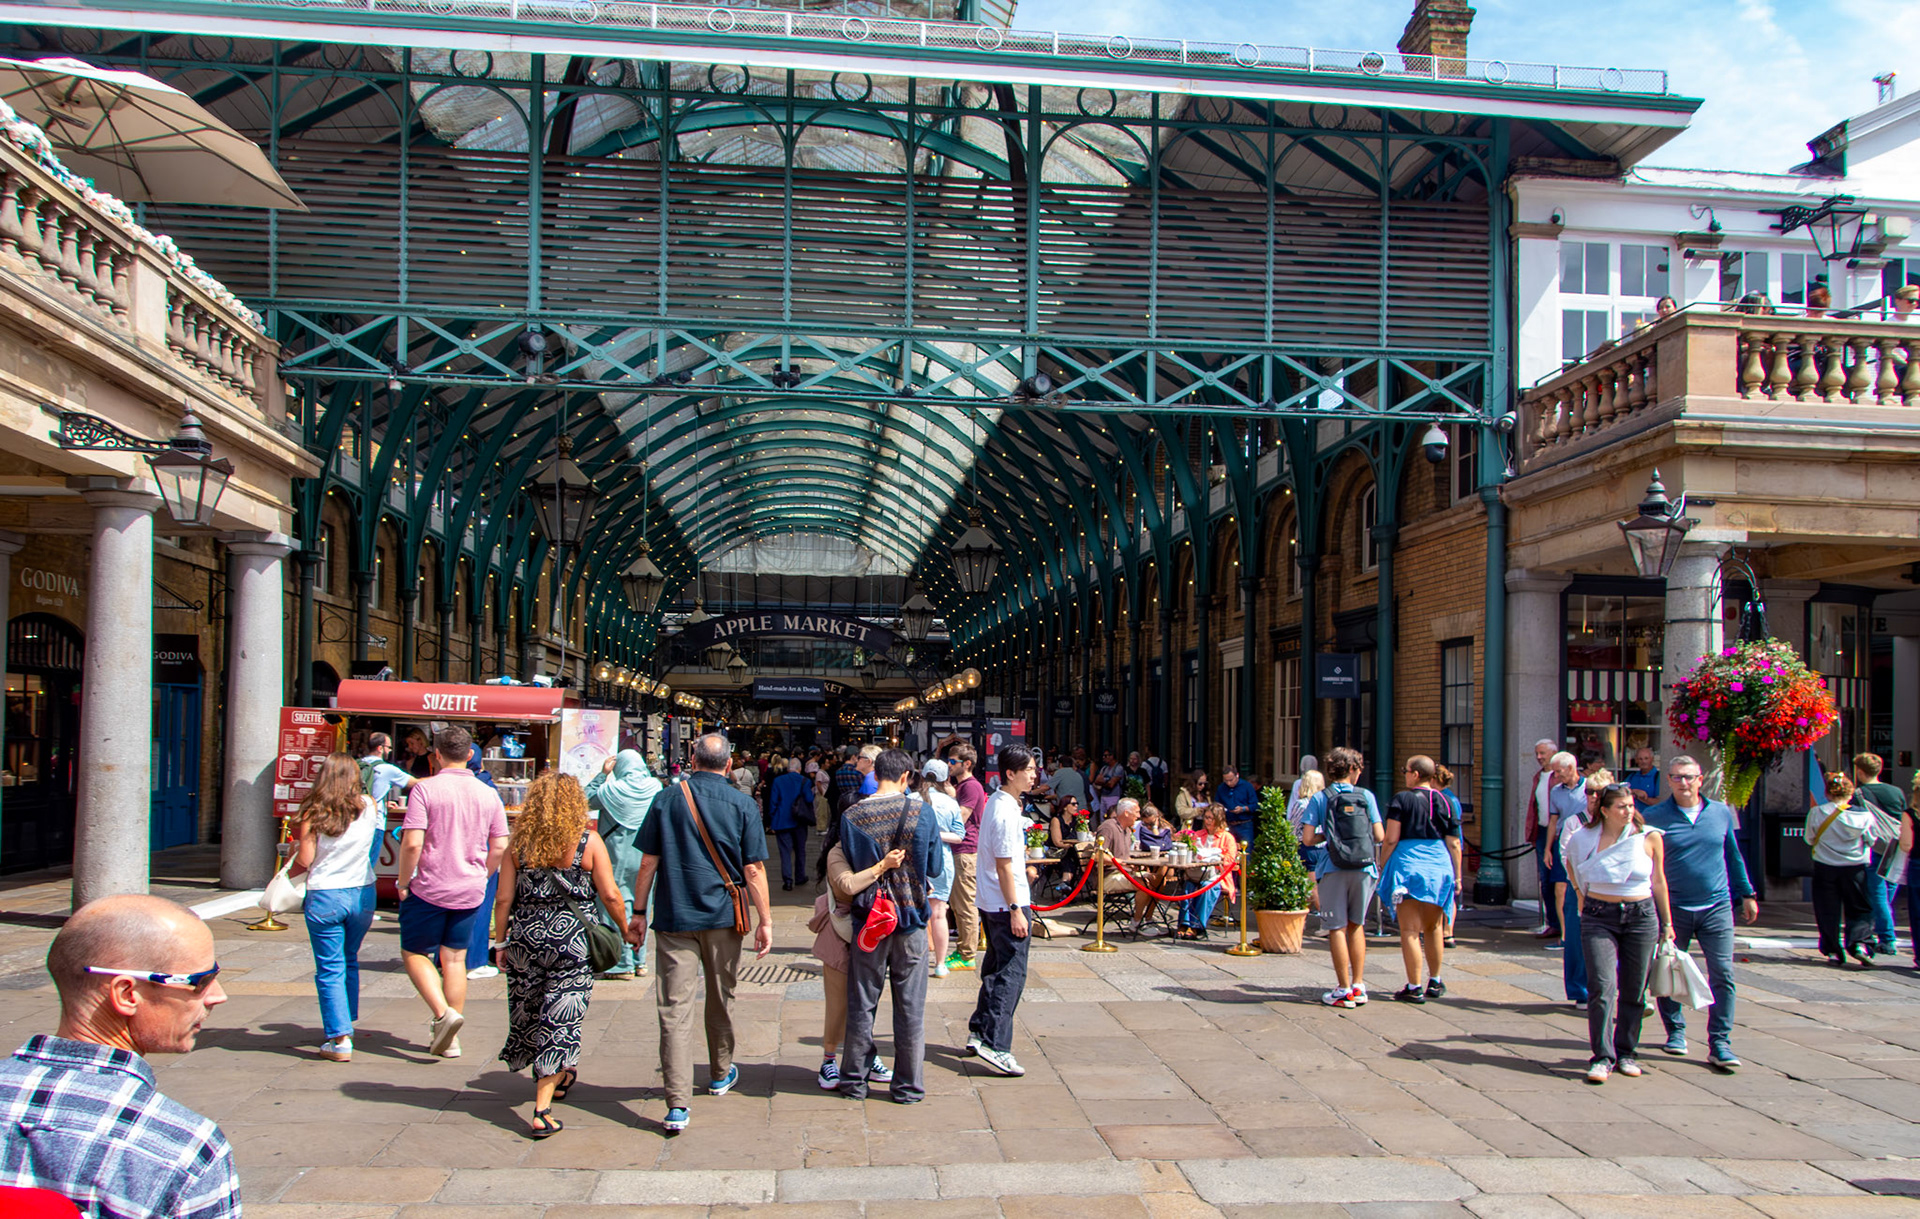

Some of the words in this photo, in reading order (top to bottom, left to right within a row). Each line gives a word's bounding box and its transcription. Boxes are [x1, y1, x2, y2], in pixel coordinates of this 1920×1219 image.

[21, 567, 79, 597] GODIVA
[713, 615, 773, 639] APPLE
[783, 614, 871, 642] MARKET
[152, 651, 194, 661] GODIVA
[802, 686, 821, 694] Design
[824, 682, 845, 695] KET
[423, 693, 479, 713] SUZETTE
[294, 713, 323, 723] SUZETTE
[1783, 827, 1805, 837] LITT
